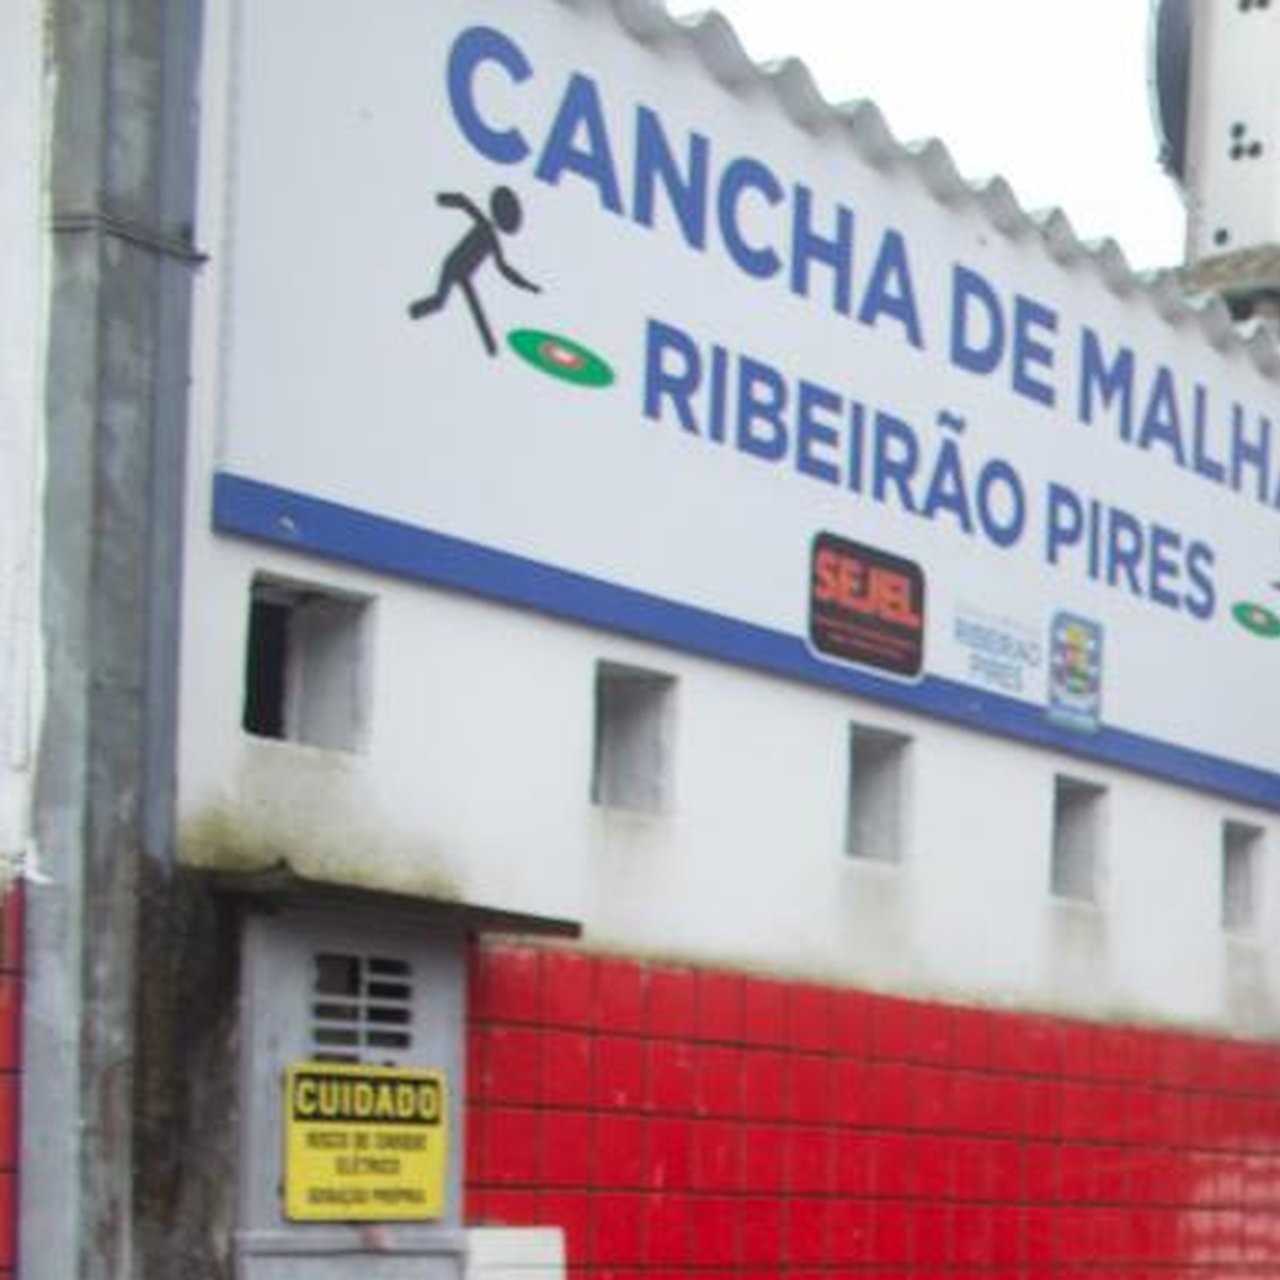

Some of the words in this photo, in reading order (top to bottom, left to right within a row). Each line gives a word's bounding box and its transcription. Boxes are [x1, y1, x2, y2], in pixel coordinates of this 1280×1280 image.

[446, 24, 925, 351] CANCHA
[948, 262, 1059, 409] DE
[641, 316, 1026, 548] RIBEIRÃO
[1045, 481, 1216, 622] PIRES
[814, 548, 921, 628] SEJEL
[296, 1079, 437, 1119] CUIDADO
